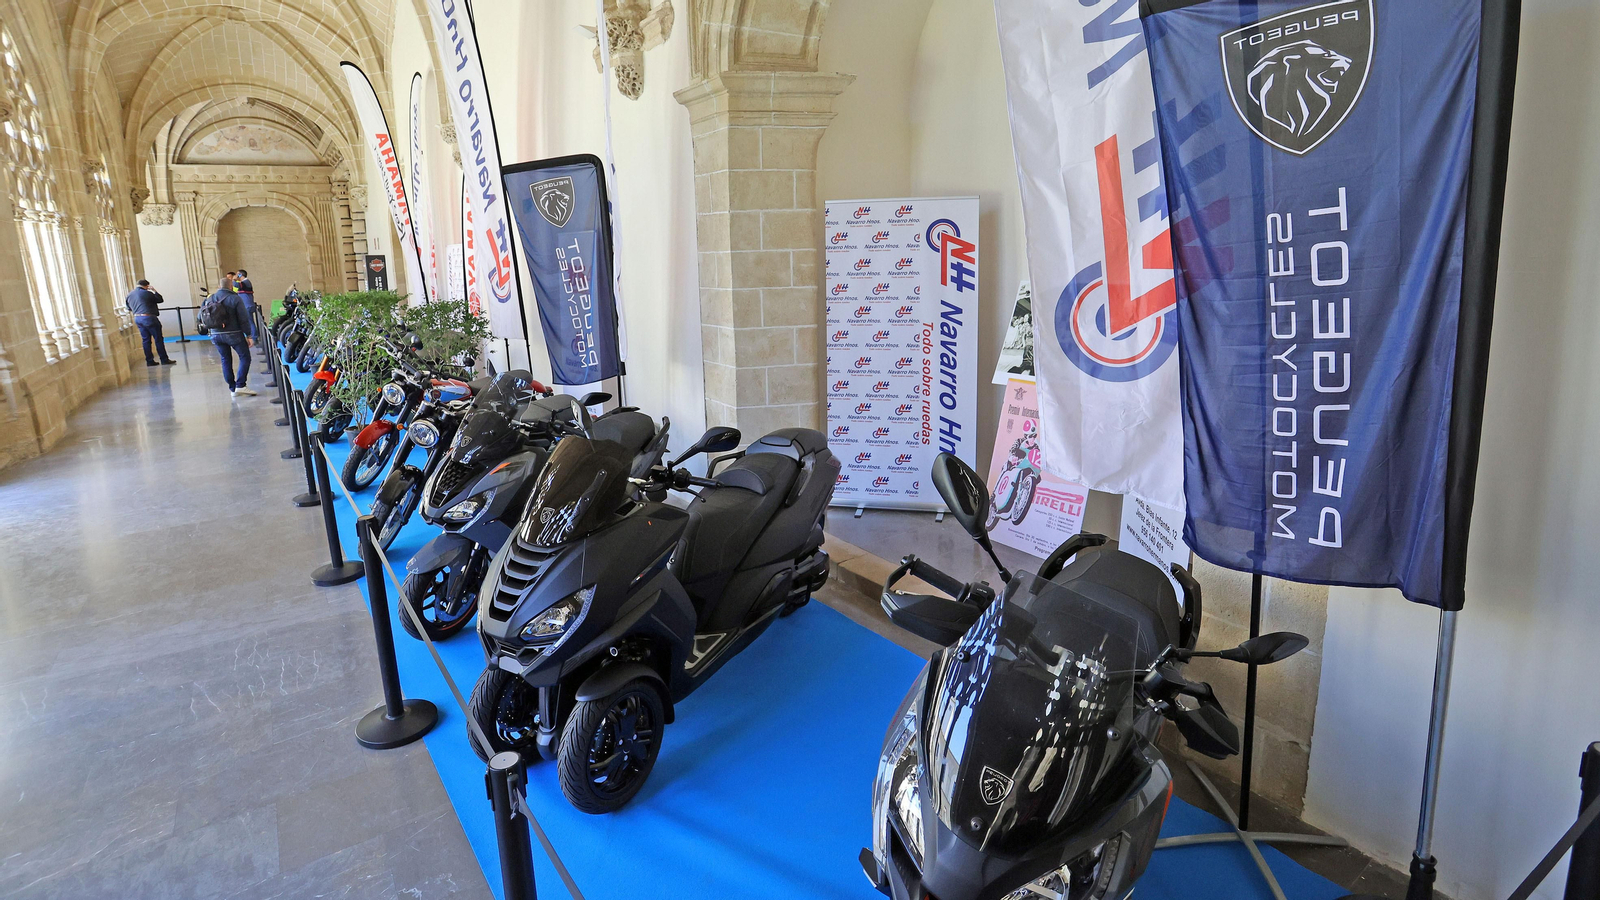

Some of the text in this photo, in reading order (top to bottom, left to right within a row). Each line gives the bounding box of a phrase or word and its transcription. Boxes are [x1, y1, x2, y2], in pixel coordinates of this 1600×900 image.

[922, 322, 934, 445] Todo sobre ruedas
[939, 300, 963, 410] Navarro
[1146, 518, 1151, 528] de
[1151, 522, 1155, 533] la
[1156, 527, 1174, 551] Frontera
[1172, 530, 1178, 540] 12
